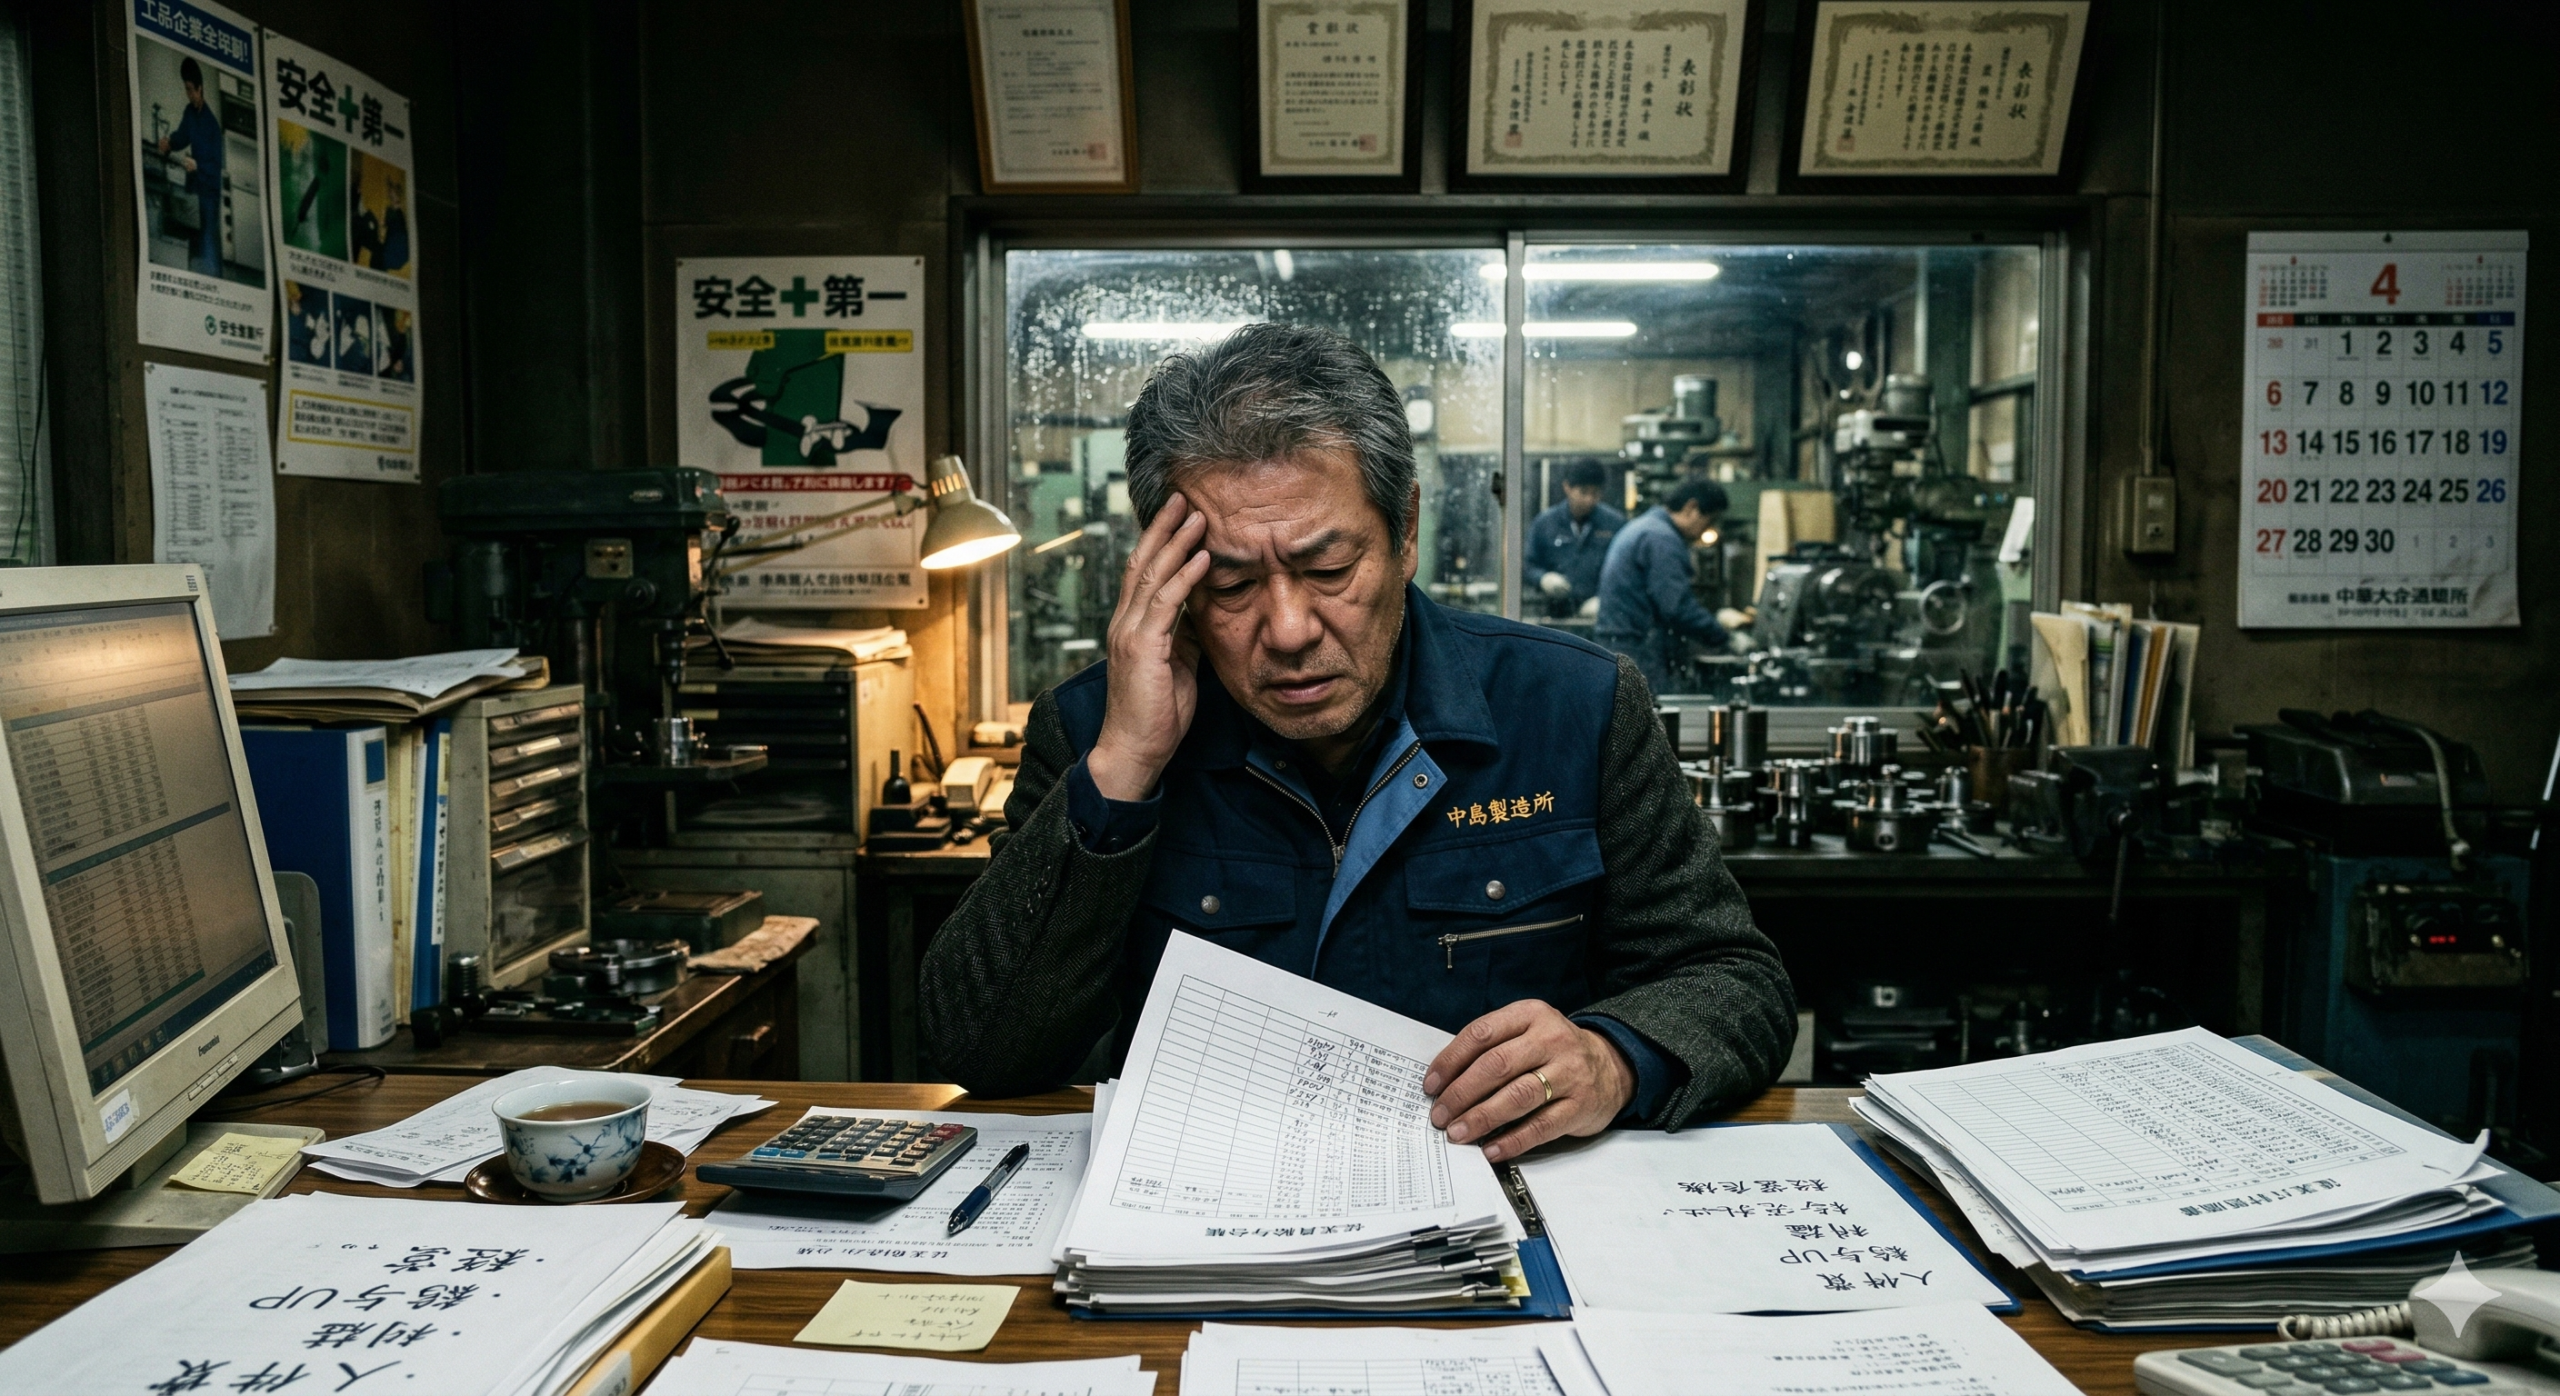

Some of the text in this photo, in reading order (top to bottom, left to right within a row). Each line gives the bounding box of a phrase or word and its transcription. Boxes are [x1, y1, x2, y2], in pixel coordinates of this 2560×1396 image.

[1675, 58, 1697, 118] 表彰状
[2008, 61, 2034, 120] 表彰状
[2371, 264, 2400, 305] 4
[2340, 331, 2351, 354] 1
[2377, 331, 2392, 355] 2
[2414, 331, 2429, 355] 3
[2450, 331, 2466, 354] 4
[2487, 331, 2503, 354] 5
[2267, 380, 2508, 406] 6 7 8 9 10 11 12
[2261, 429, 2507, 455] 13 14 15 16 17 18 19
[2257, 478, 2506, 504] 20 21 22 23 24 25 26
[2257, 529, 2286, 553] 27
[2294, 529, 2322, 554] 28
[2329, 529, 2359, 553] 29
[2365, 529, 2395, 553] 30
[2449, 535, 2458, 549] 2
[1447, 791, 1555, 829] 中島製造所
